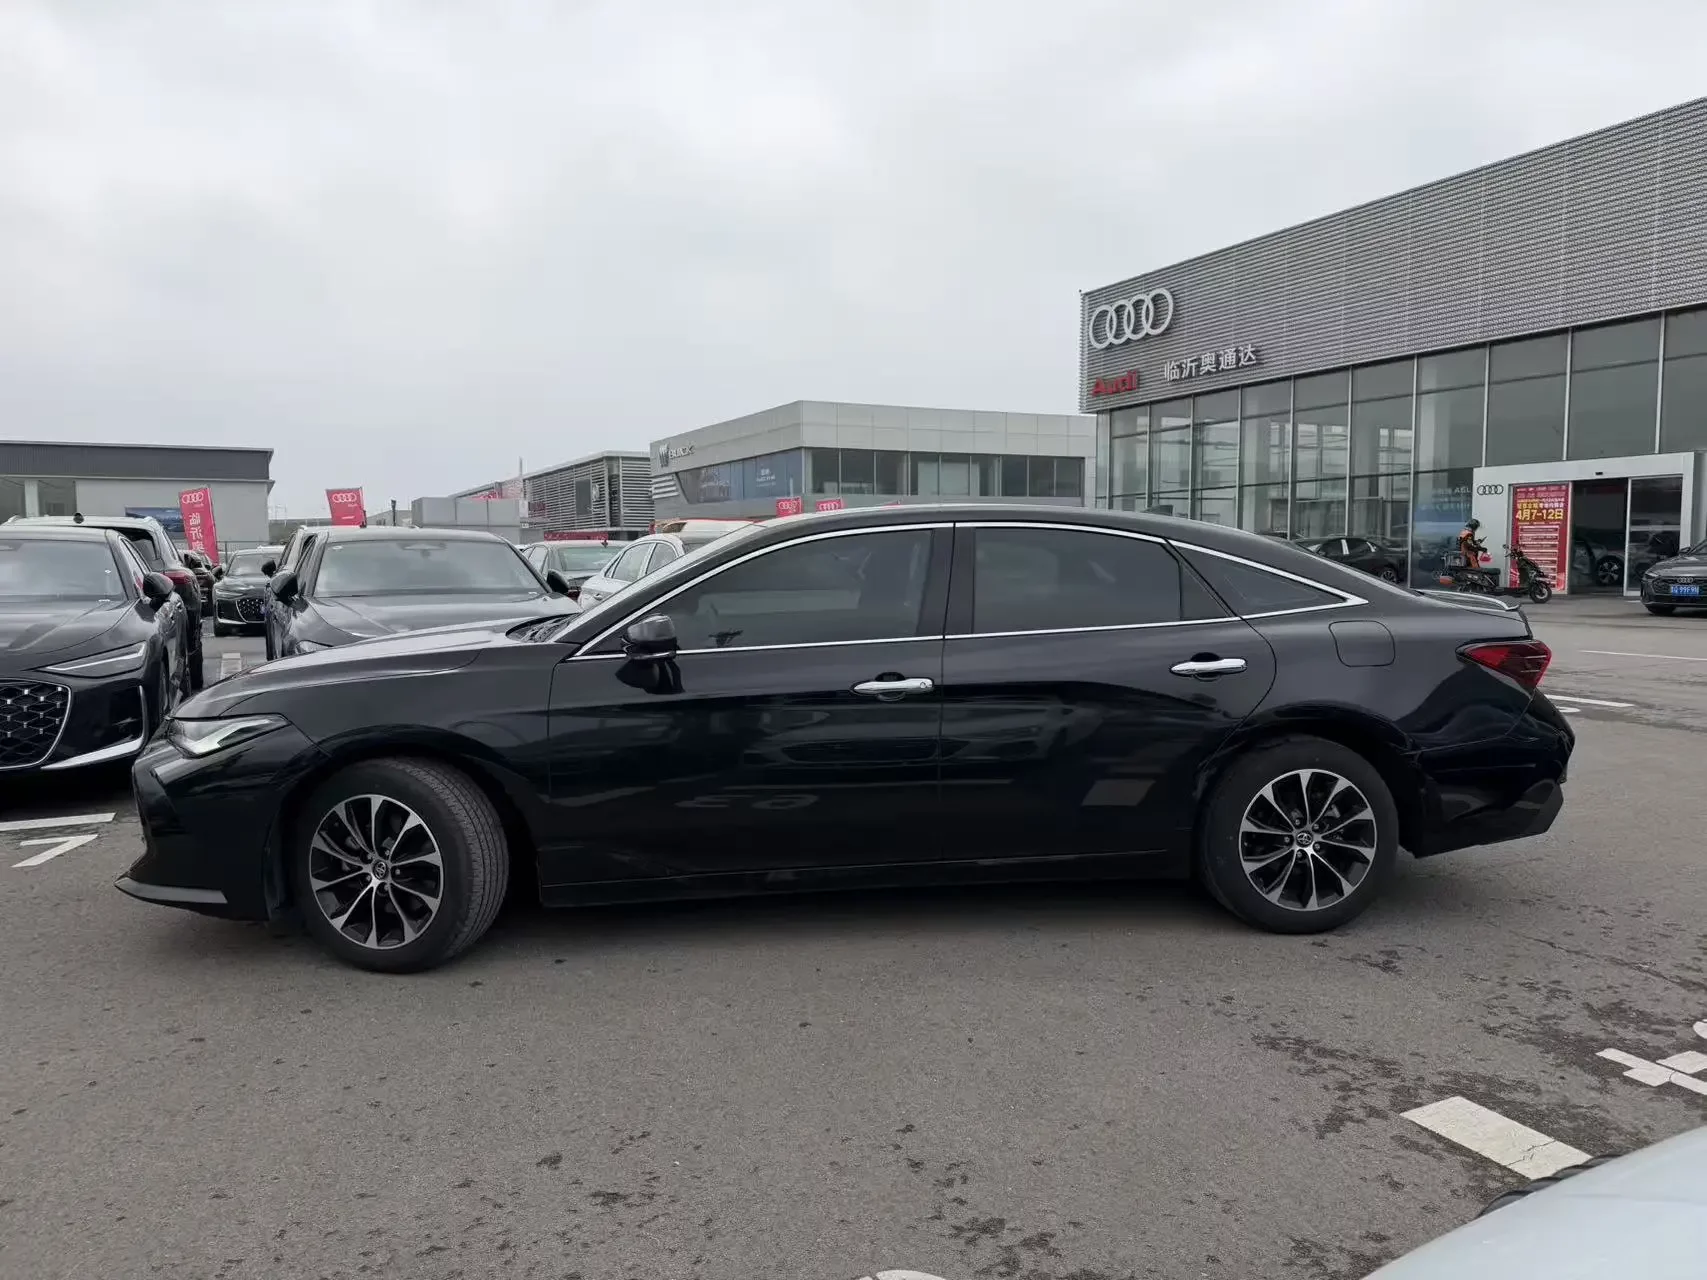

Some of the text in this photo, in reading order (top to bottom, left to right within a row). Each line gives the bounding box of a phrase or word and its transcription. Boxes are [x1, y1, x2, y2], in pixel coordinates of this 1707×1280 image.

[1164, 344, 1257, 381] 临沂奥通达
[1091, 369, 1137, 397] Audi
[1515, 508, 1564, 520] 4月7-12日
